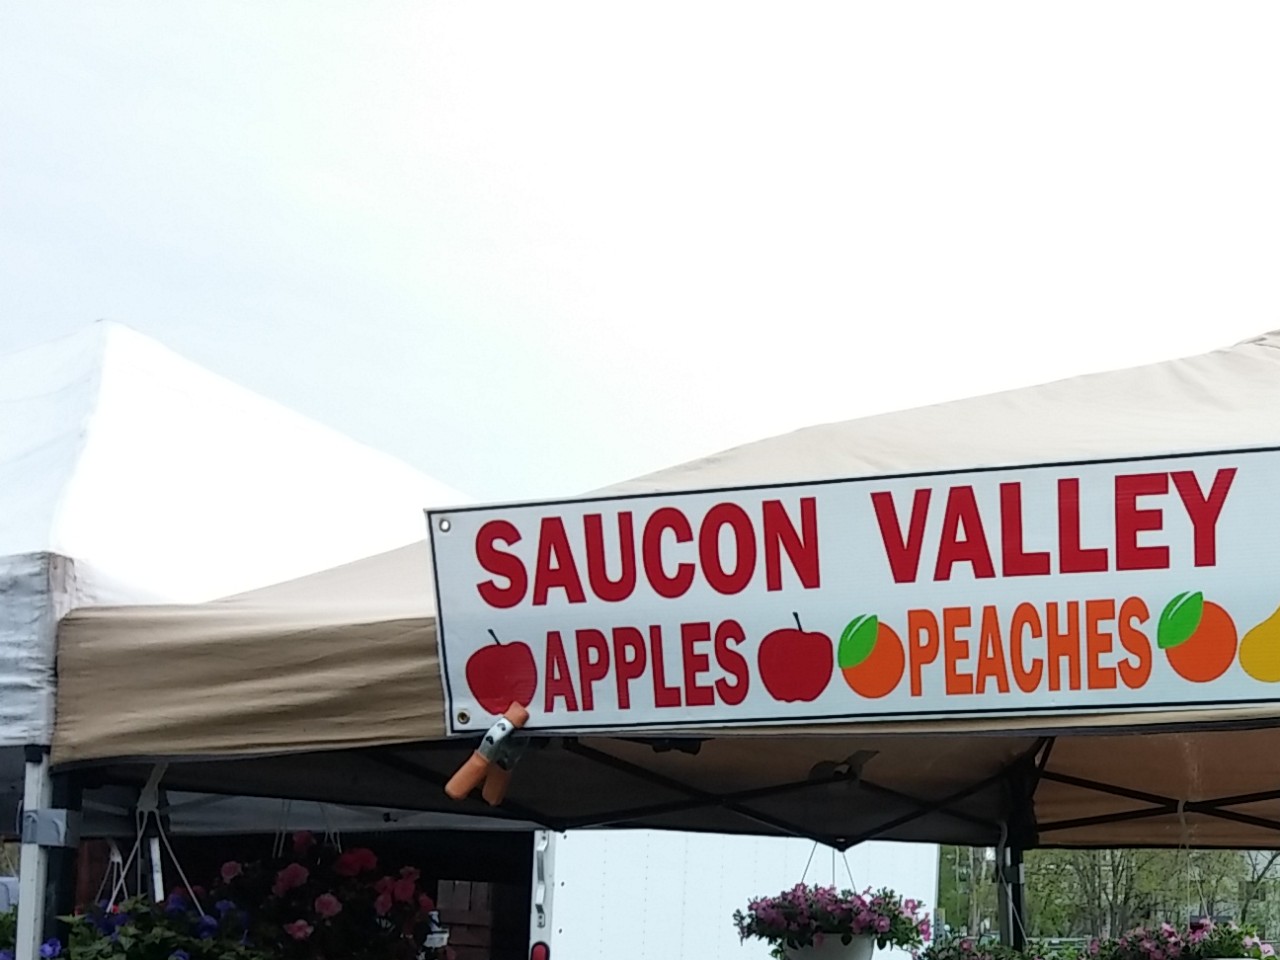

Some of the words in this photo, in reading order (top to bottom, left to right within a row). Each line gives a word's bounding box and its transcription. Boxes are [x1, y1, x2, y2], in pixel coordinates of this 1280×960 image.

[475, 496, 820, 609] SAUCON
[870, 467, 1238, 584] VALLEY
[544, 619, 749, 713] APPLES
[907, 595, 1152, 697] PEACHES
